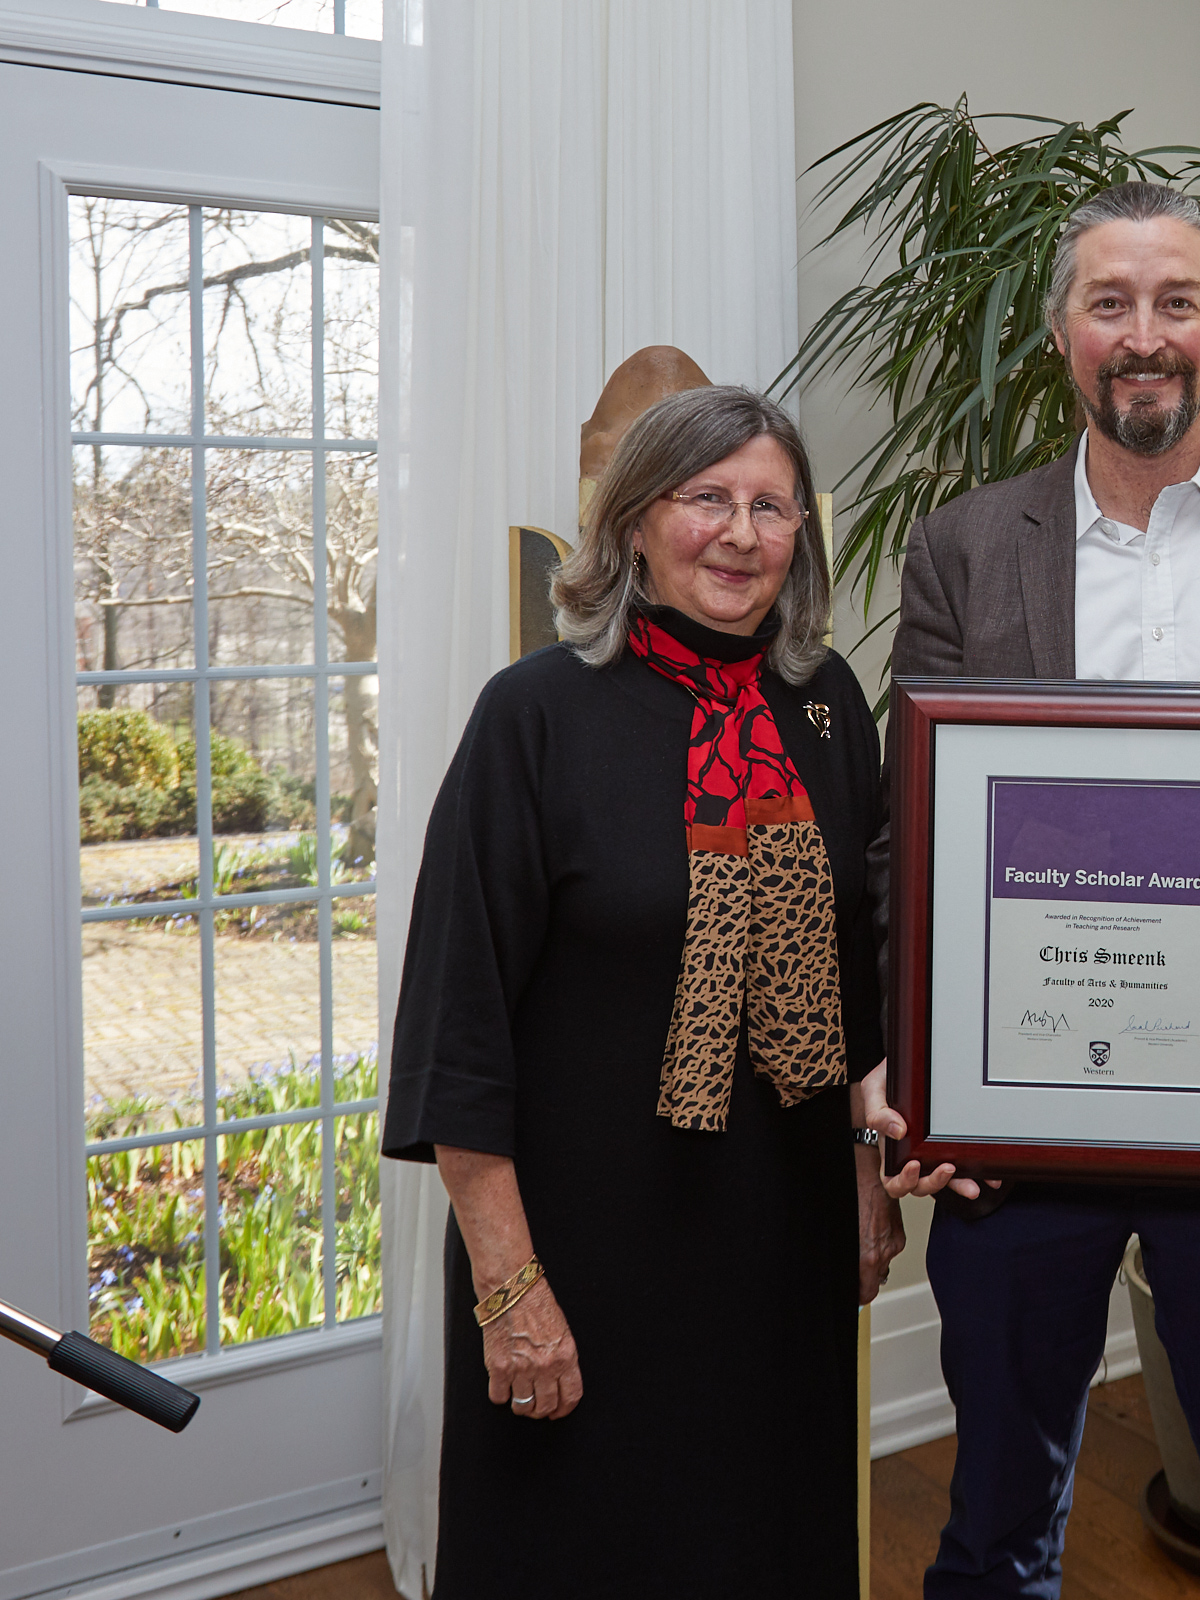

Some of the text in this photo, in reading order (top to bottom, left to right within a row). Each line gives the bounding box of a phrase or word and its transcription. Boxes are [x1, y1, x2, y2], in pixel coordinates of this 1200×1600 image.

[1005, 867, 1071, 888] Faculty
[1074, 869, 1145, 887] Scholar
[1044, 913, 1071, 921] Awarded
[1078, 914, 1115, 923] Recognition
[1122, 916, 1162, 924] Achievement
[1072, 922, 1099, 931] Teaching
[1112, 924, 1141, 932] Research
[1039, 945, 1166, 967] Chris Smeenk
[1042, 977, 1169, 990] Faculty of Arts & Humanities
[1088, 998, 1115, 1008] 2020
[1083, 1067, 1115, 1076] Western
